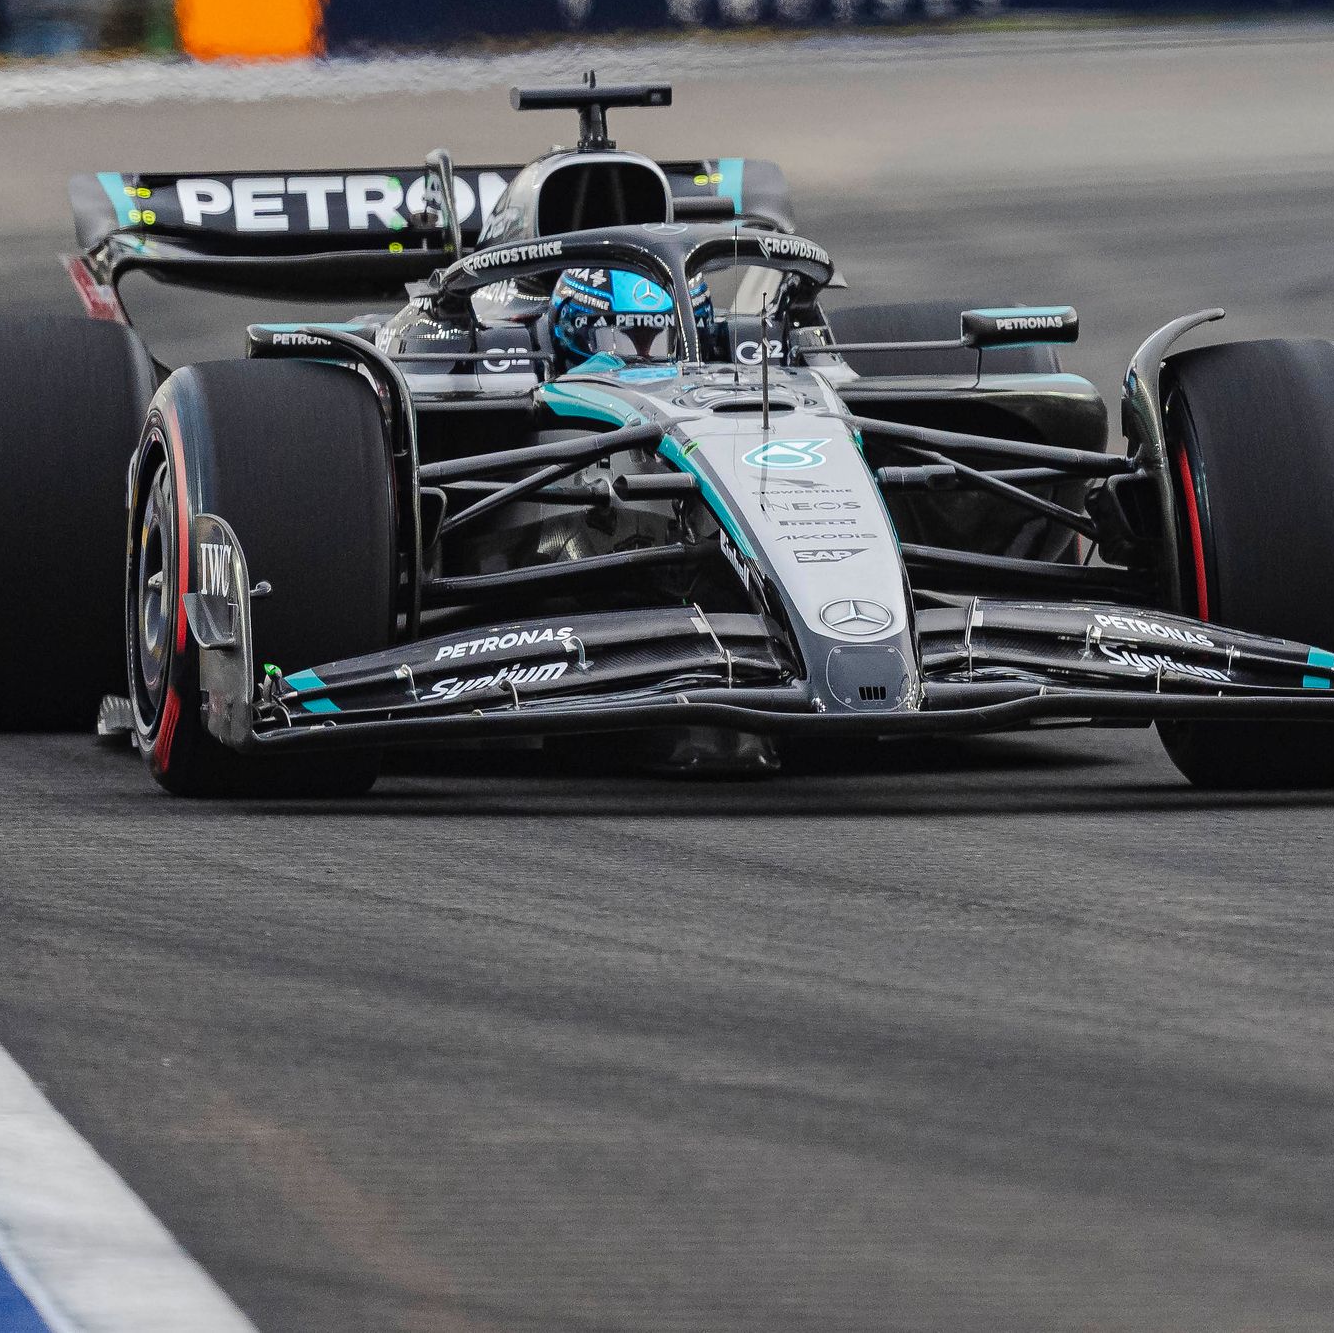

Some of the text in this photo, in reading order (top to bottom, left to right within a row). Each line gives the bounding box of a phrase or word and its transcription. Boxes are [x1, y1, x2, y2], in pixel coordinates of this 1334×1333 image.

[464, 240, 563, 272] CROWDSTRIKE
[995, 316, 1064, 330] PETRONAS
[200, 543, 232, 597] IWC
[795, 549, 854, 562] SAP
[434, 627, 573, 662] PETRONAS
[1094, 614, 1215, 648] PETRONAS
[1099, 643, 1232, 682] Syntium
[420, 662, 569, 700] Syntium
